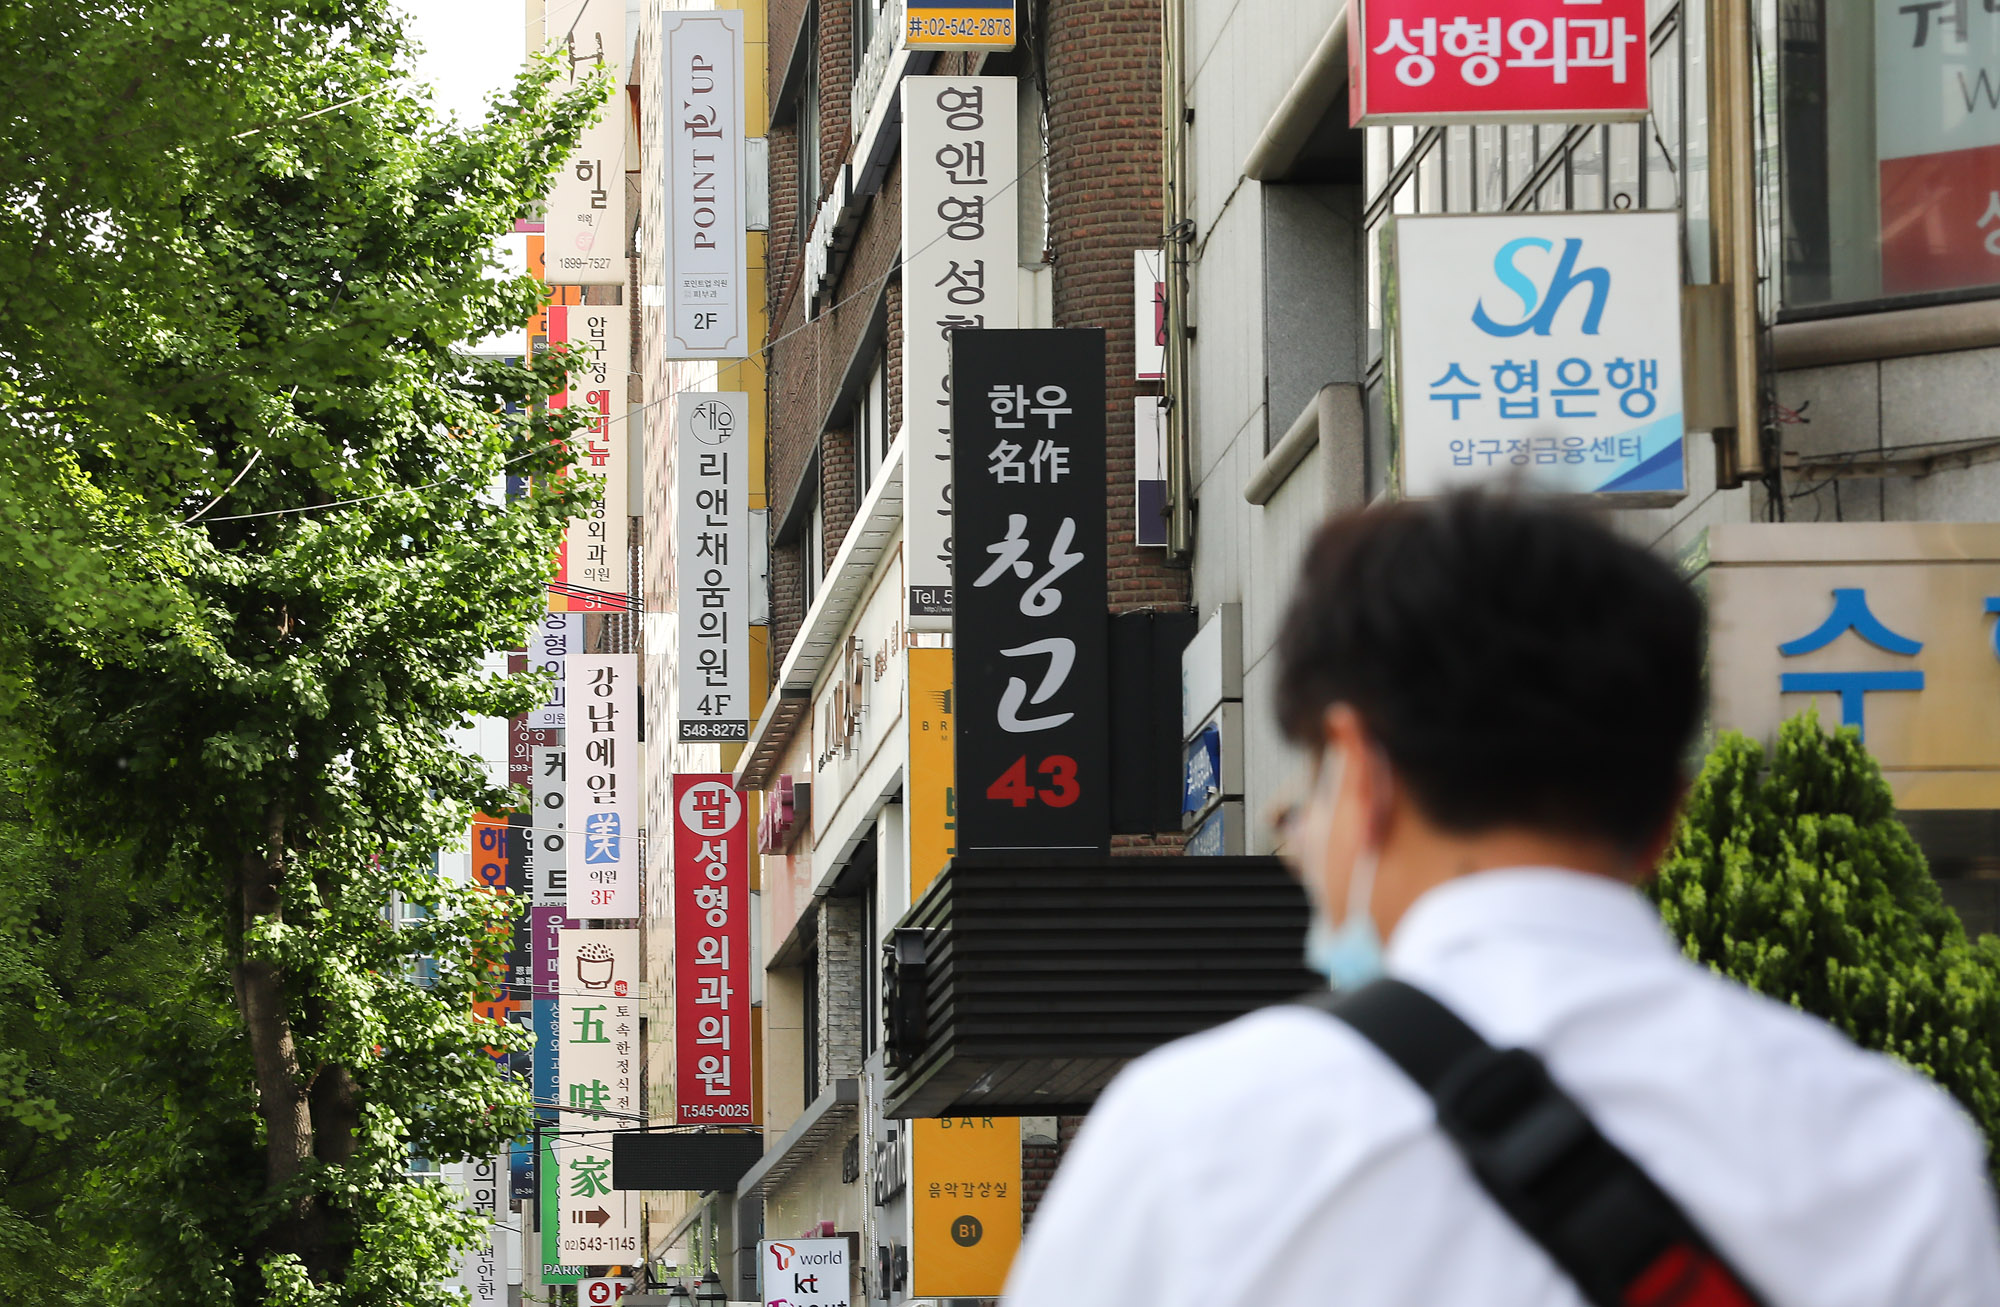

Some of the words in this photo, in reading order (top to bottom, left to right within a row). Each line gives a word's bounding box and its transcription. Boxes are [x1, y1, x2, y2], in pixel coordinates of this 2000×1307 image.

[1373, 16, 1638, 87] 성형외과
[692, 54, 714, 95] UP
[936, 85, 988, 241] 영앤영
[692, 149, 716, 250] POINT
[559, 257, 611, 269] 1899-7527
[693, 290, 717, 298] 피부과
[713, 279, 728, 288] 의원
[1471, 237, 1611, 338] Sh
[694, 312, 718, 330] 2F
[587, 316, 607, 384] 압구정
[1429, 357, 1659, 421] 수협은행
[987, 384, 1073, 429] 한우
[987, 439, 1070, 484] 名作
[1449, 435, 1643, 467] 압구정금융센터
[584, 567, 610, 583] 의원
[695, 452, 731, 687] 리앤채움의원
[911, 589, 941, 604] Tel.
[972, 513, 1084, 733] 창고
[696, 694, 731, 716] 4F
[683, 723, 746, 737] 548-8275
[986, 753, 1081, 808] 43
[692, 789, 731, 830] 팝
[589, 869, 617, 886] 의원
[590, 889, 615, 906] 3F
[693, 839, 733, 1097] 성형외과의원
[681, 1104, 750, 1119] T.545-0025
[941, 1116, 994, 1129] BAR
[928, 1182, 1007, 1199] 음악감상실
[958, 1224, 977, 1238] B1
[564, 1236, 635, 1252] 02)543-1145
[800, 1250, 842, 1265] world
[543, 1263, 582, 1276] PARK
[794, 1272, 819, 1294] kt
